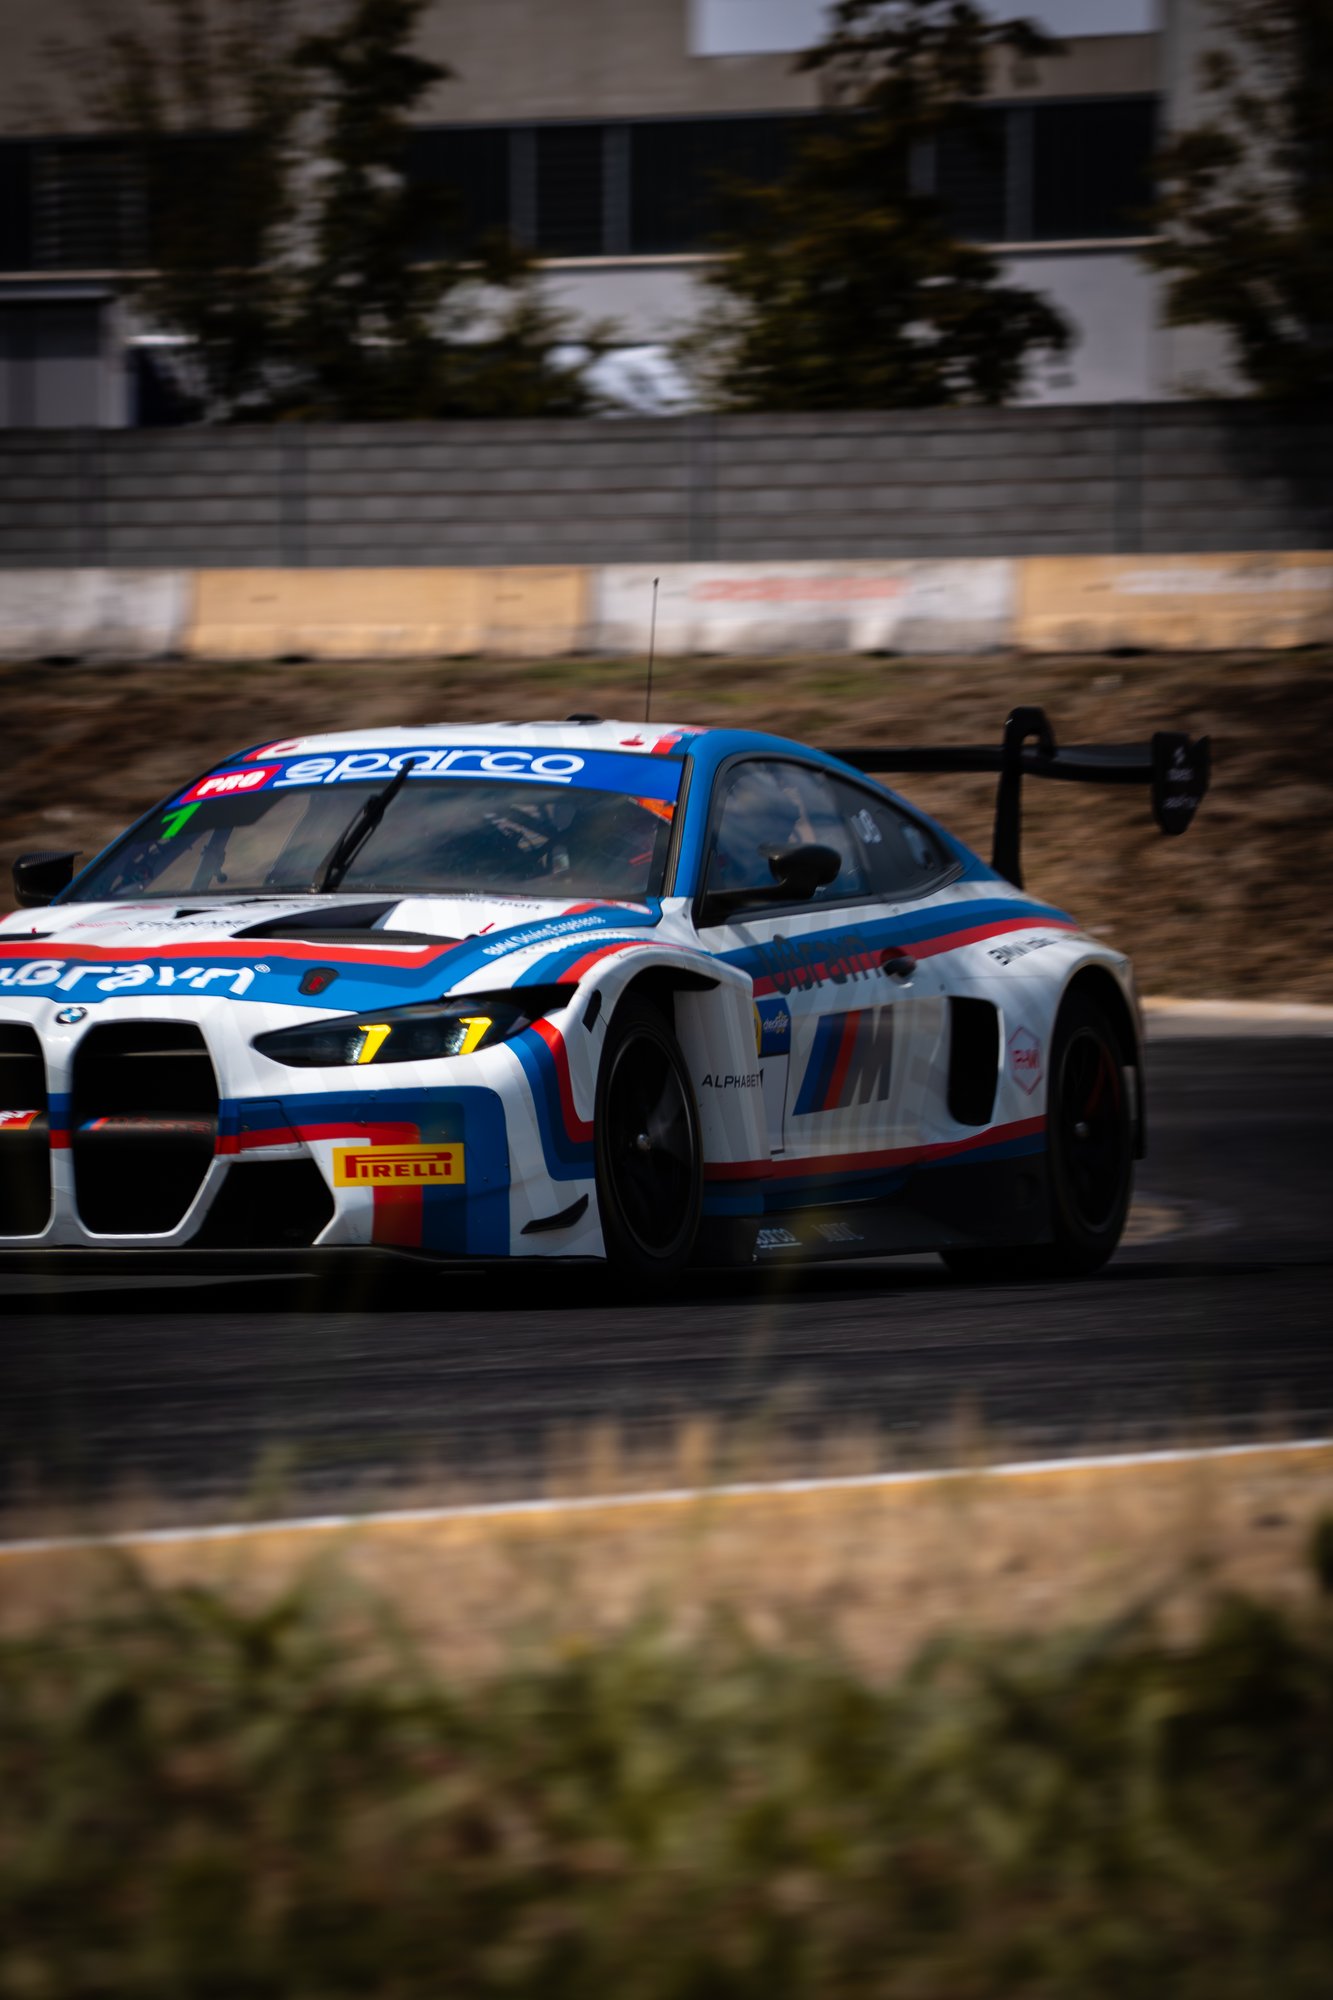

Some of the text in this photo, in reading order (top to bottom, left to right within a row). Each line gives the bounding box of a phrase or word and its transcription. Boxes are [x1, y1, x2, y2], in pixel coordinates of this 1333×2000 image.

[197, 749, 585, 796] PRO sparco
[161, 802, 202, 839] 1
[702, 1074, 761, 1089] ALPHABET
[344, 1152, 453, 1178] PIRELLI
